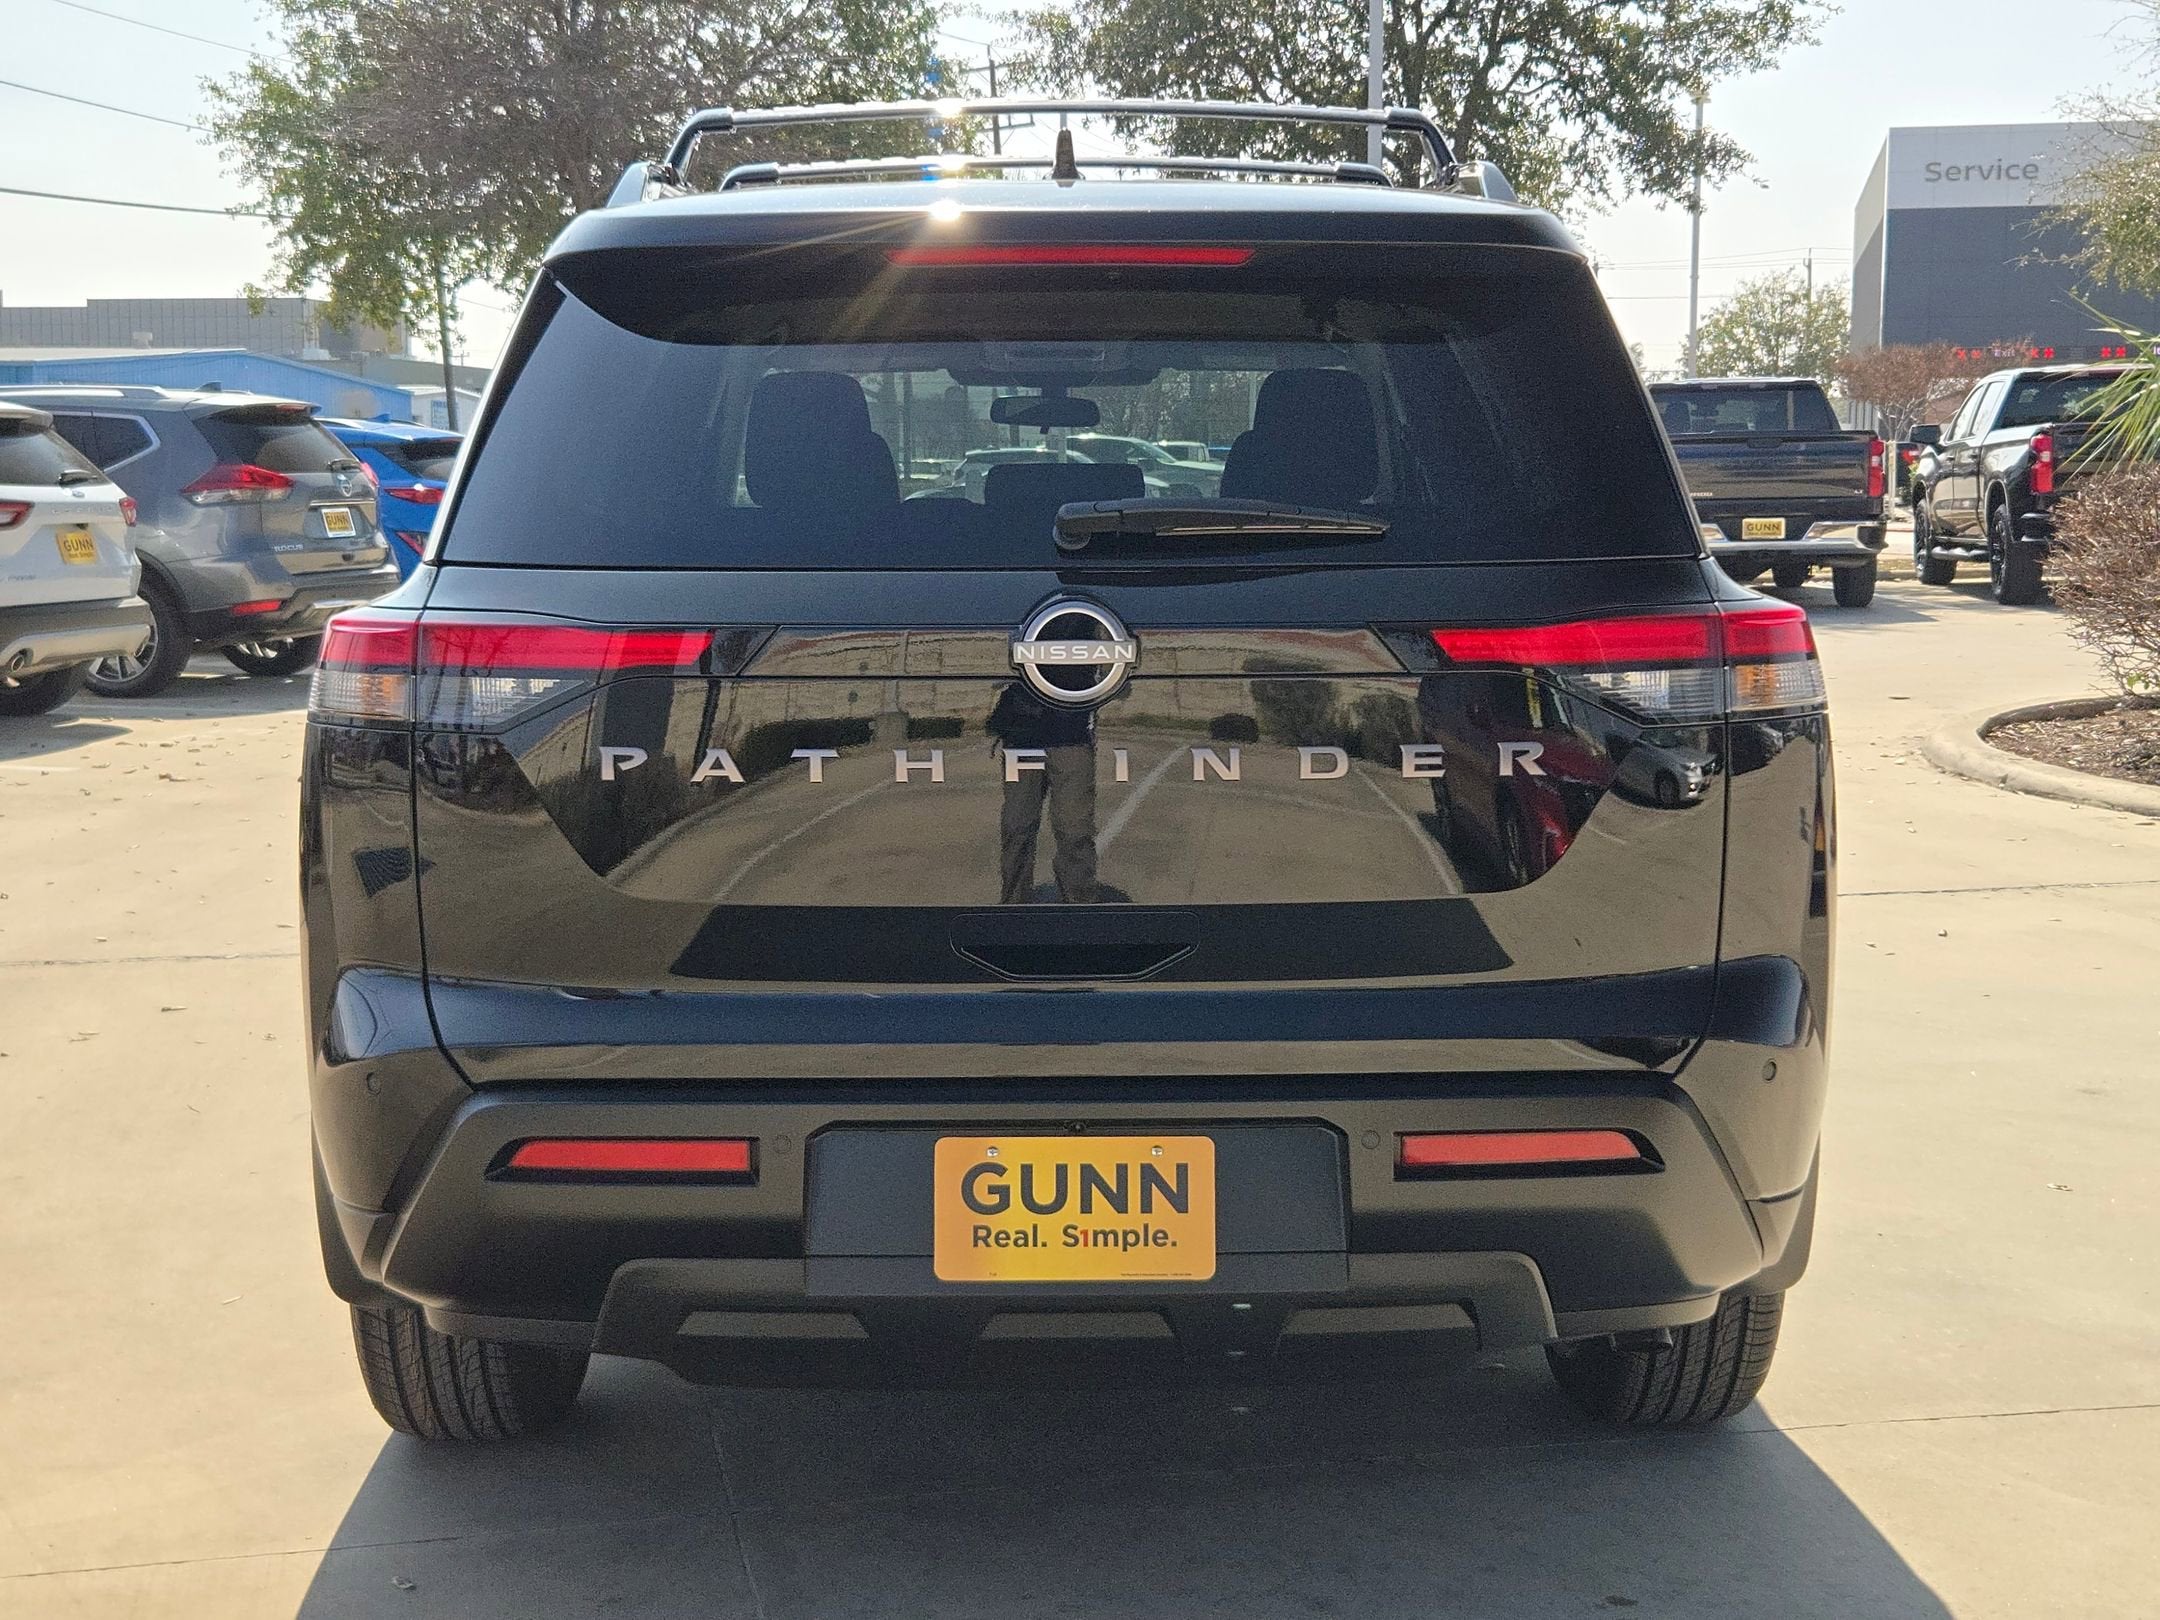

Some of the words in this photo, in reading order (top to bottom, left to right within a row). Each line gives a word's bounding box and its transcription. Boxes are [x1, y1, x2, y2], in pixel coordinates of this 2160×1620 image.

[1924, 158, 2040, 182] Service
[326, 514, 349, 526] GUNN
[1746, 523, 1780, 532] GUNN
[63, 538, 94, 552] GUNN
[1016, 644, 1133, 660] NISSAN
[599, 740, 1548, 784] PATHFINDER
[960, 1161, 1190, 1216] GUNN
[972, 1223, 1048, 1248] Real.
[1062, 1223, 1178, 1252] S1mple.
